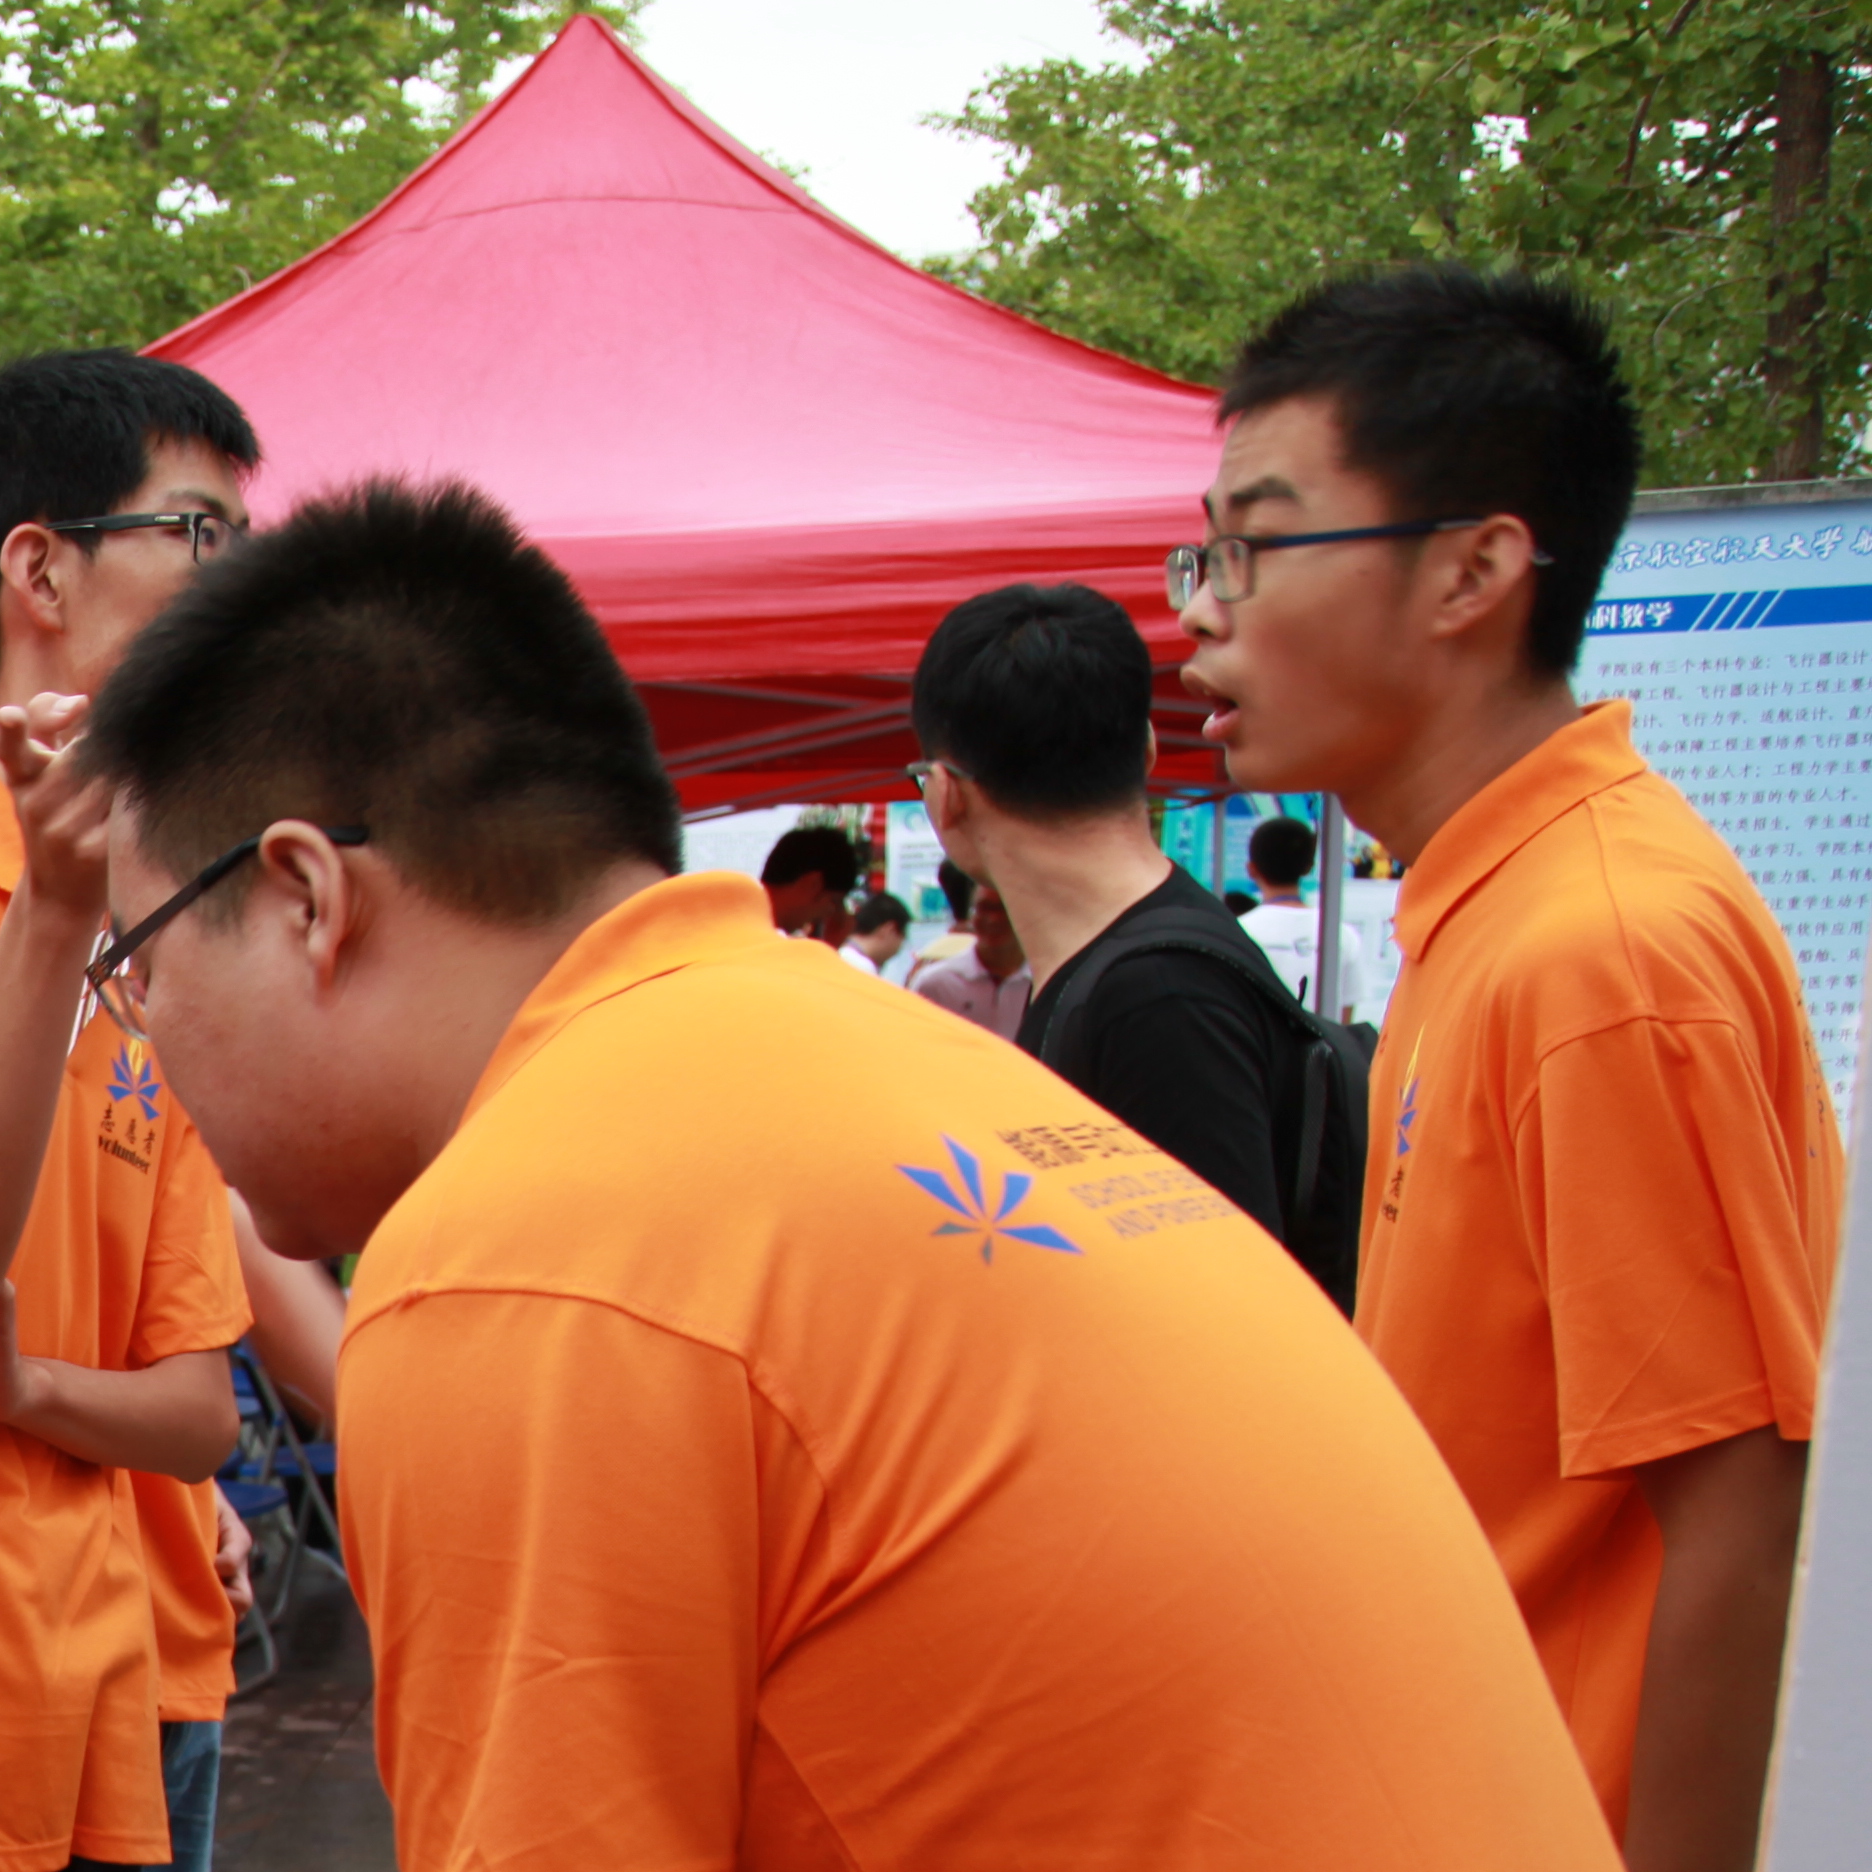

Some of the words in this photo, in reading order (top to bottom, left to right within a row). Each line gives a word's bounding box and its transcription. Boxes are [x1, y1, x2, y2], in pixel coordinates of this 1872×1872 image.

[1609, 526, 1844, 572] 京航空航天大学
